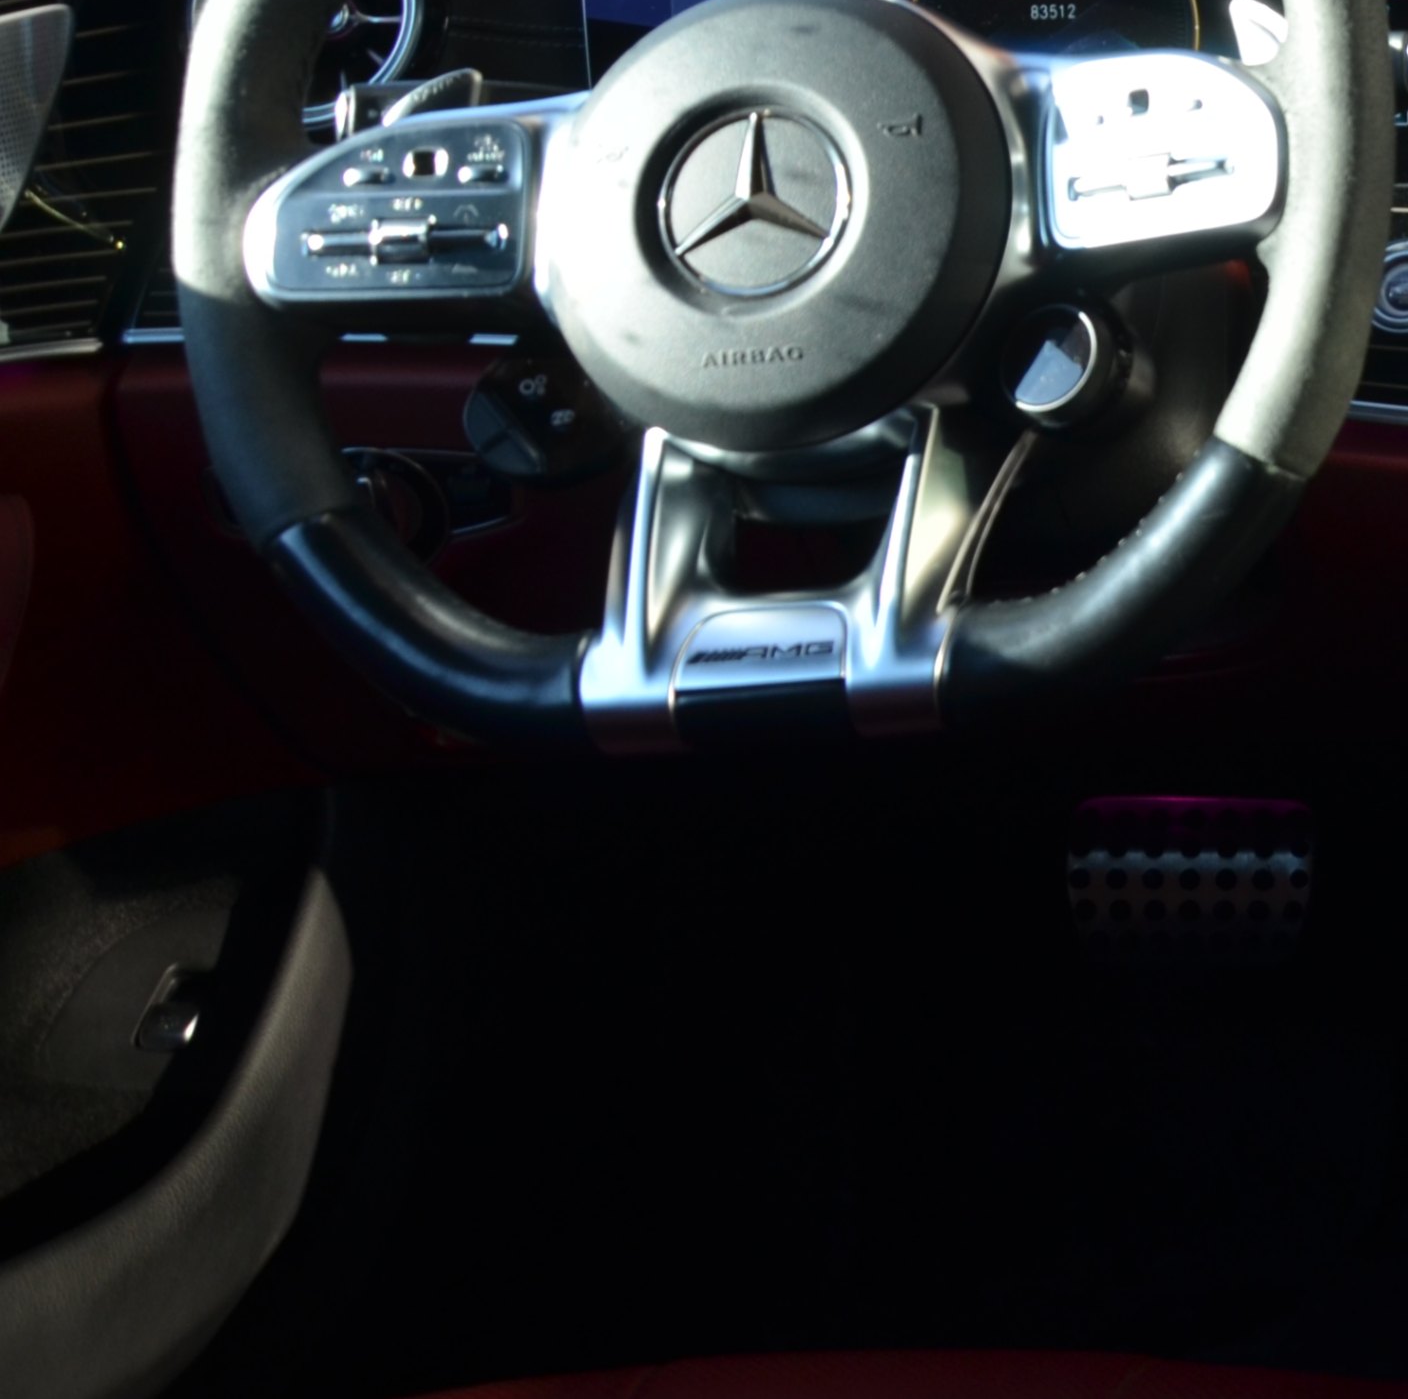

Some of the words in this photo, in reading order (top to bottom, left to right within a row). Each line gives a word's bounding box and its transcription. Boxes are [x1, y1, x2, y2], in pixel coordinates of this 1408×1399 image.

[1030, 3, 1076, 20] 83512
[703, 345, 806, 370] AIRBAG
[745, 639, 836, 659] AMG
